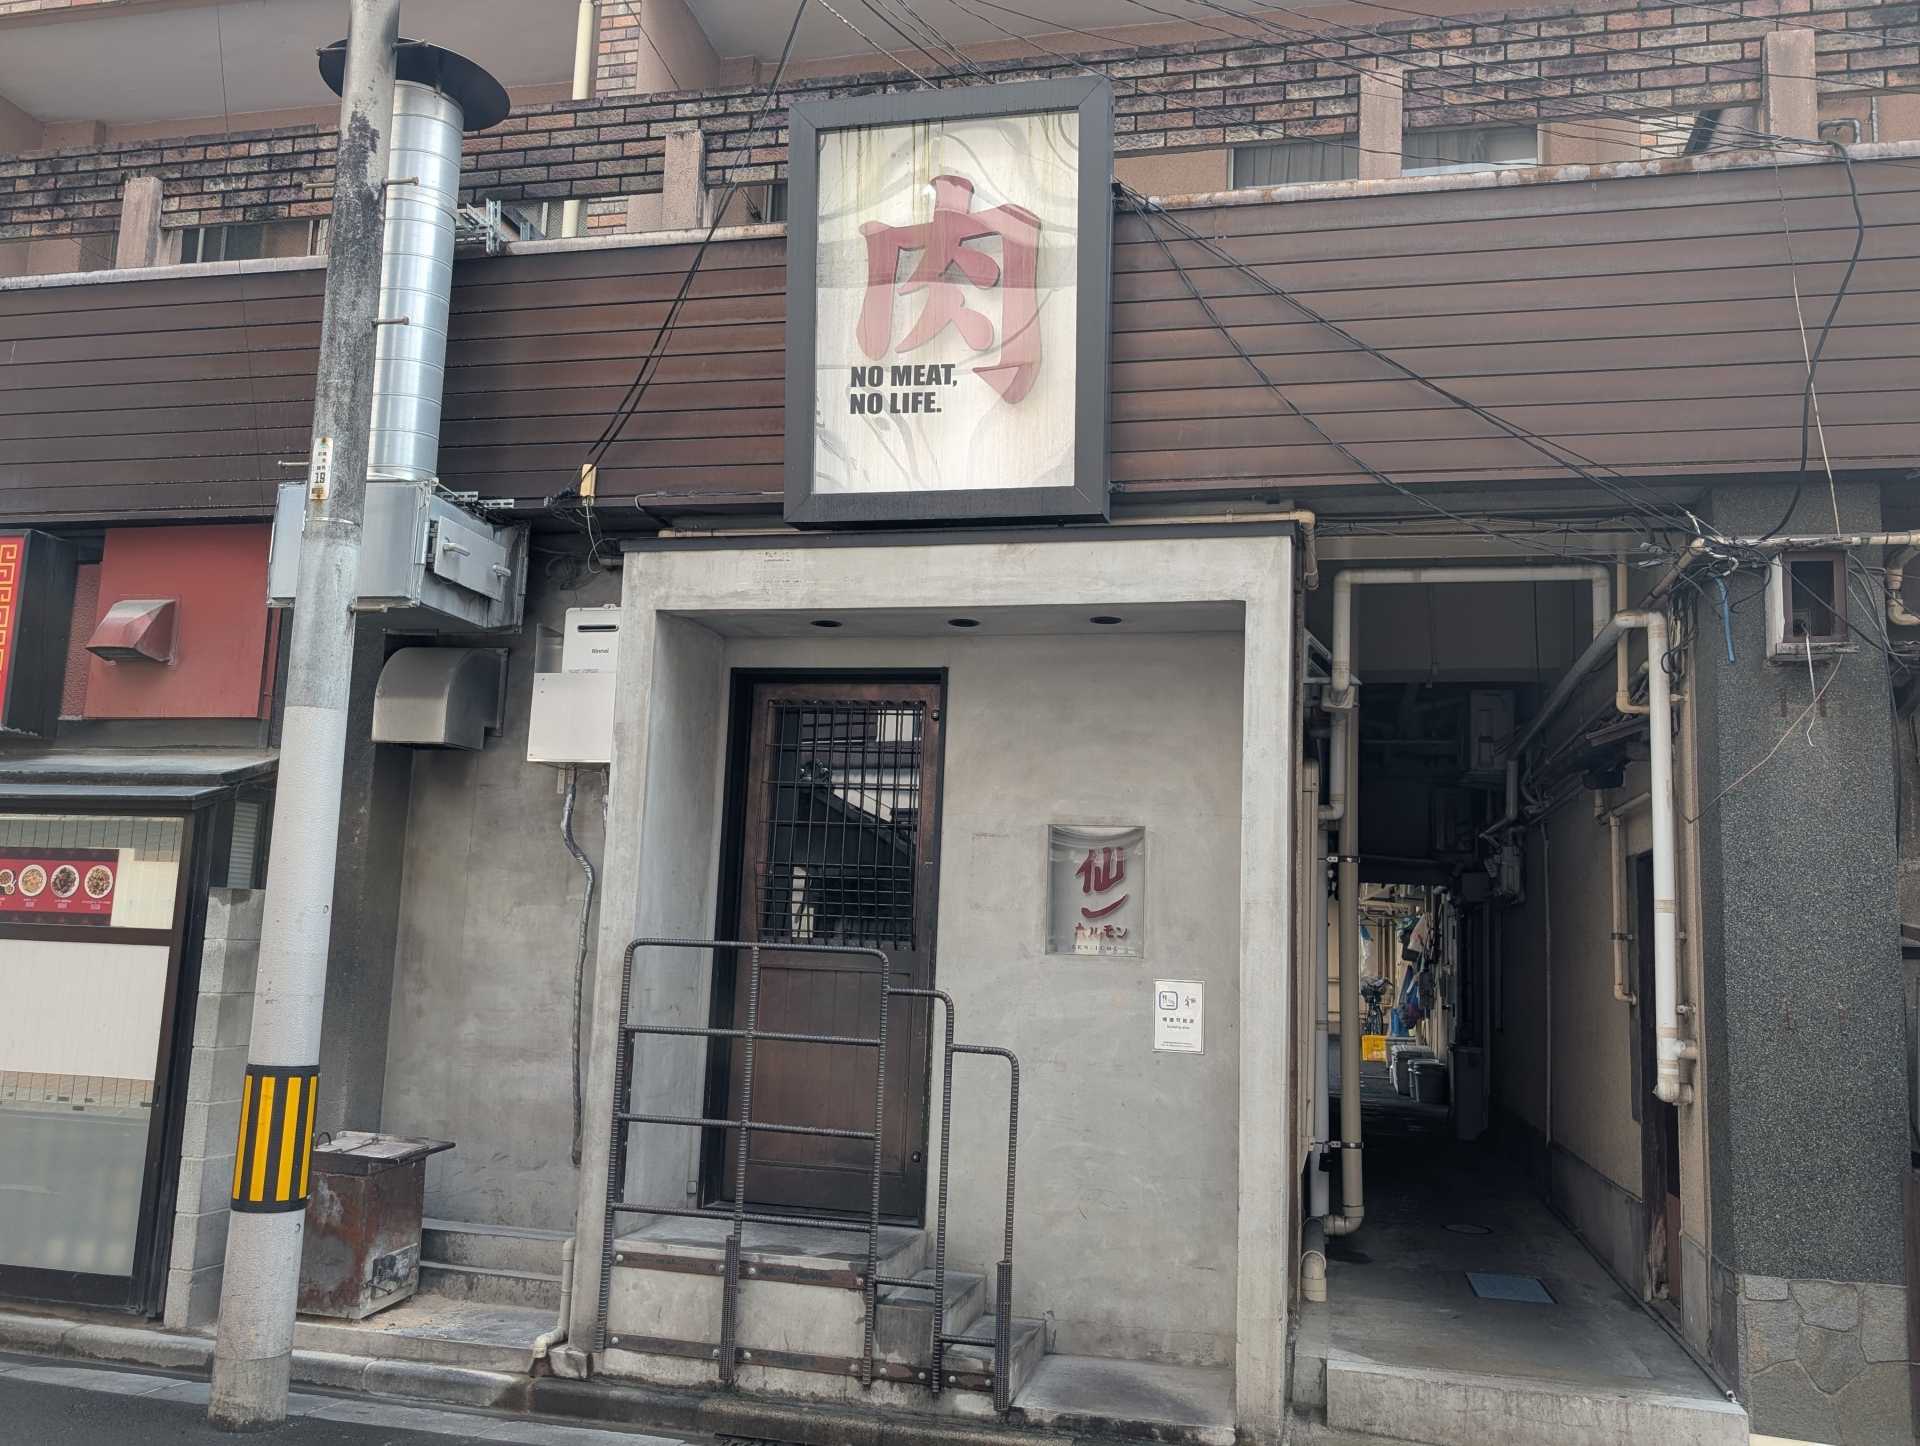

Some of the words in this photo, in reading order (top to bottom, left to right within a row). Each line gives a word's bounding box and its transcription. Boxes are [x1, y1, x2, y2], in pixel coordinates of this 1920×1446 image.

[856, 175, 1041, 404] 肉
[850, 366, 884, 387] NO
[890, 364, 958, 387] MEAT,
[850, 393, 883, 414] NO
[890, 392, 942, 413] LIFE.
